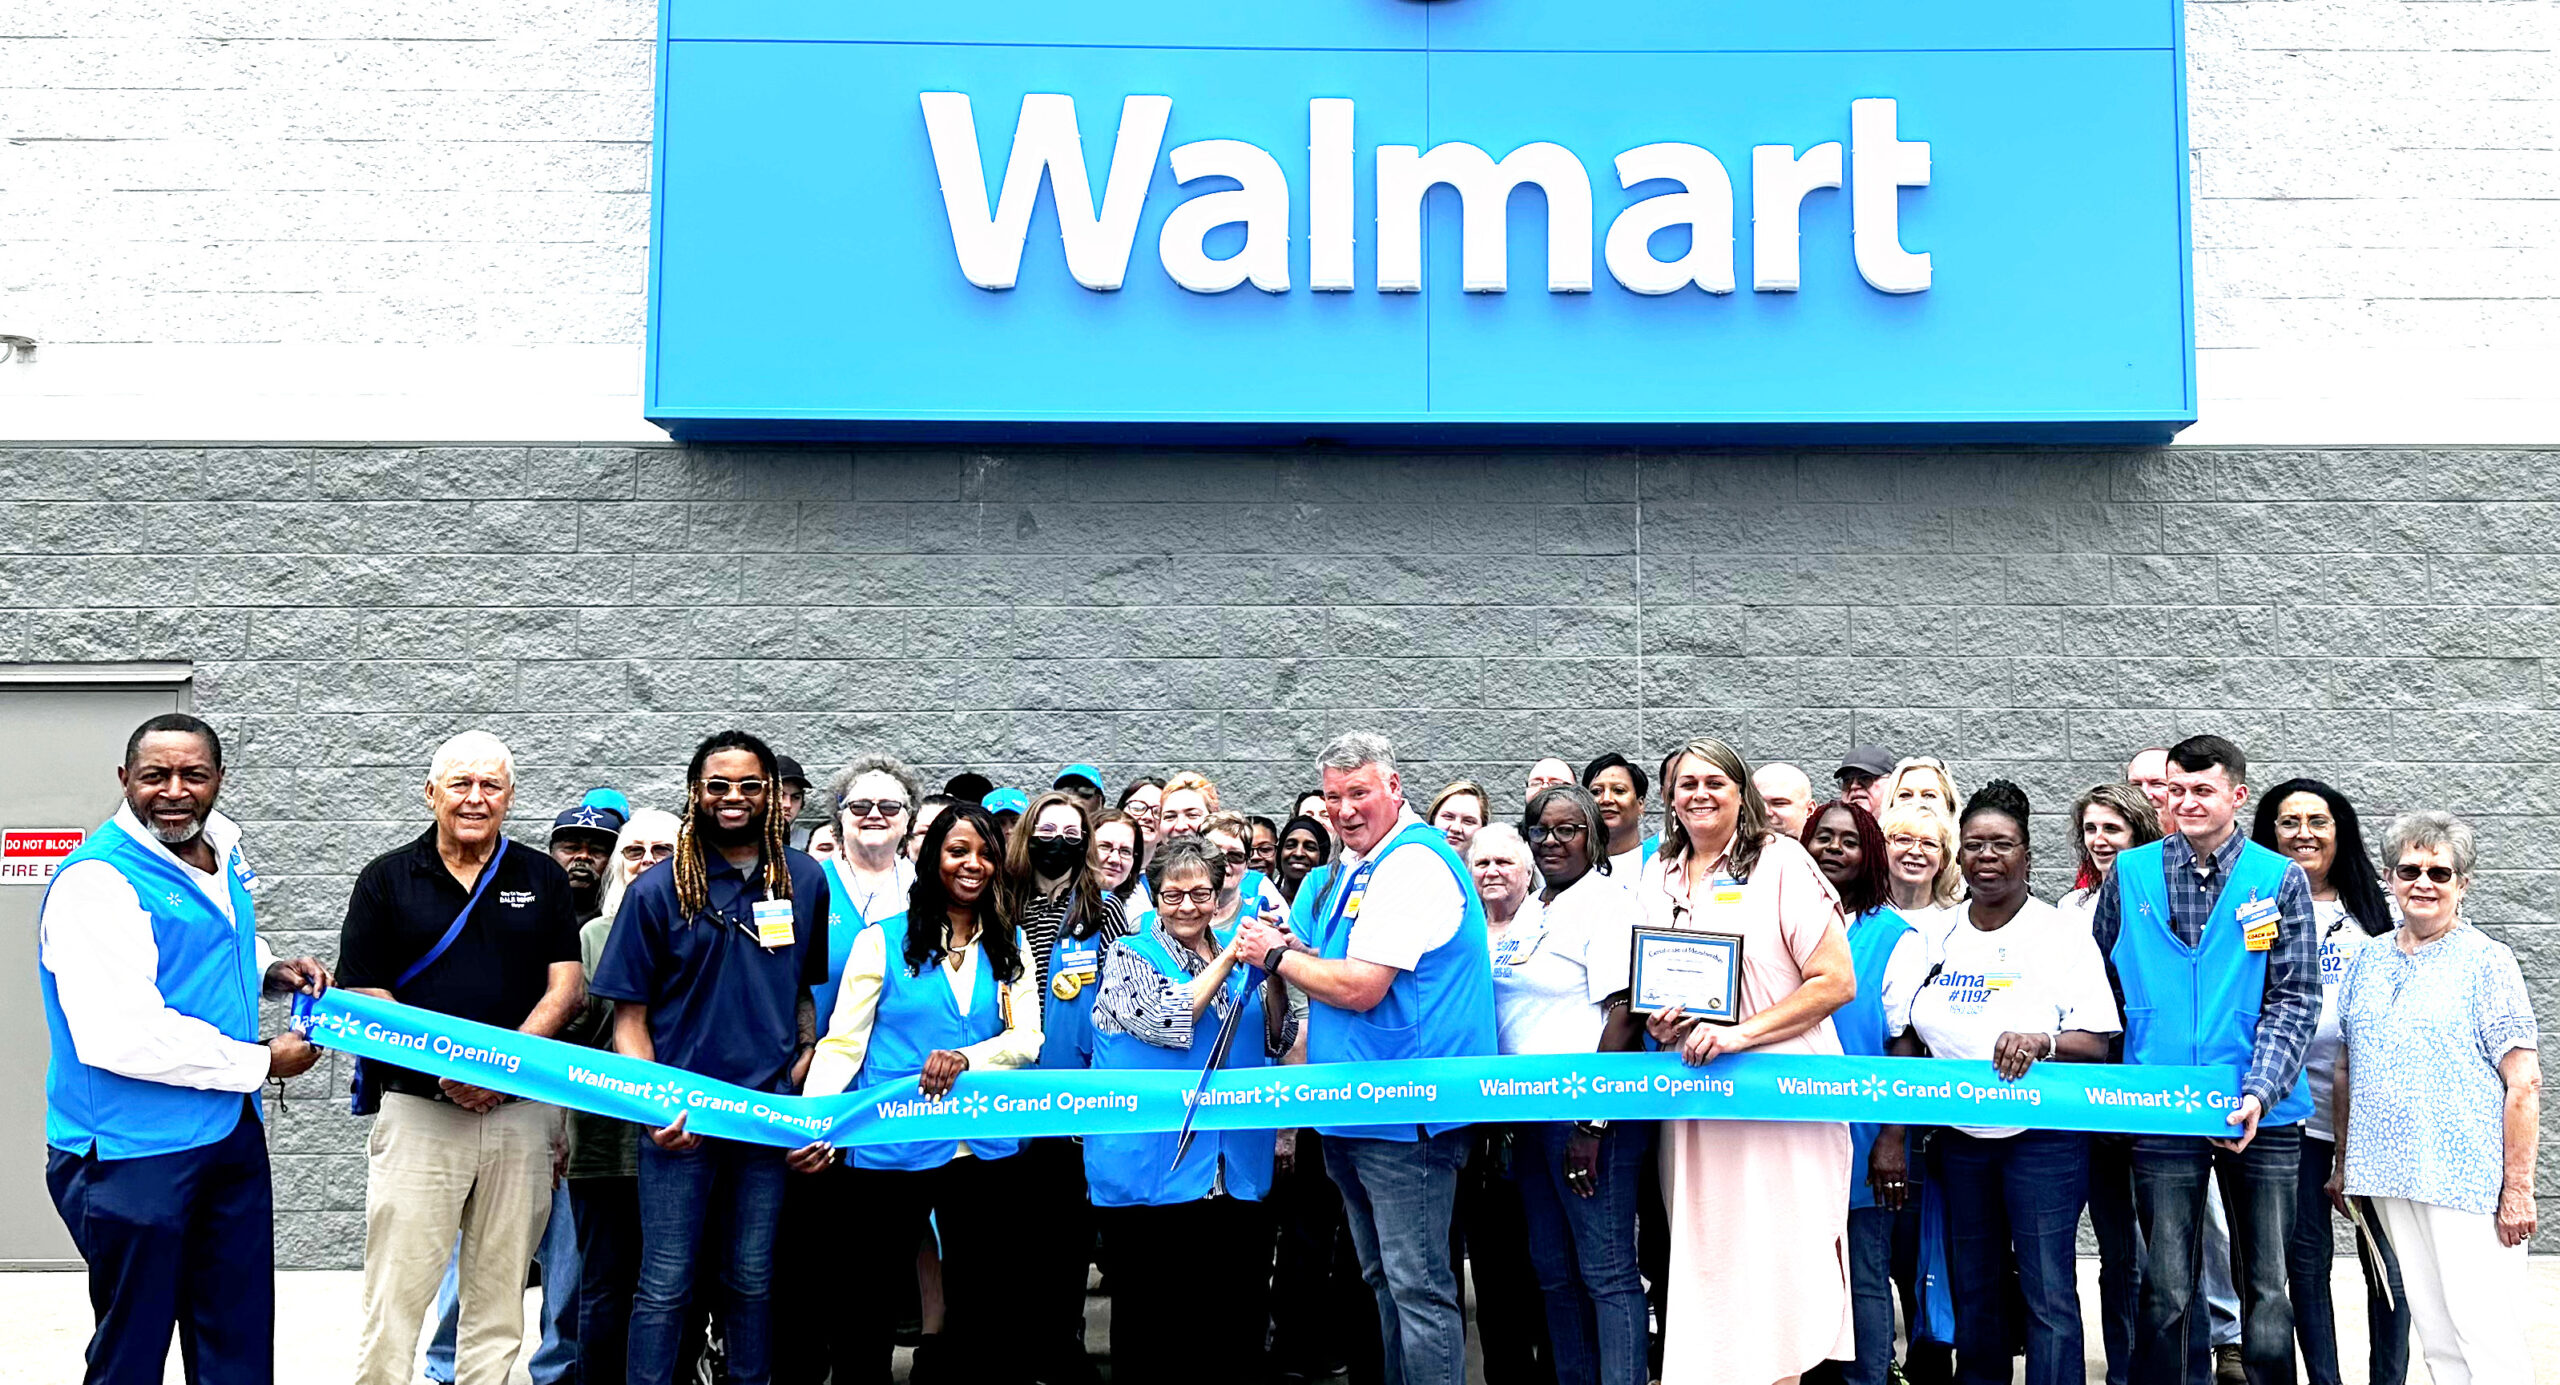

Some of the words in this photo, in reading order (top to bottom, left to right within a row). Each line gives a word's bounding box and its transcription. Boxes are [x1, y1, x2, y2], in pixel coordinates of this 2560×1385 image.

[919, 91, 1932, 295] Walmart
[6, 840, 20, 850] DO
[23, 840, 44, 850] NOT
[45, 840, 80, 850] BLOCK
[2, 864, 38, 877] FIRE
[1933, 970, 1985, 988] alma
[1948, 989, 1991, 1003] #1192
[364, 1022, 428, 1050] Grand
[433, 1036, 521, 1073] Opening
[1295, 1083, 1351, 1102] Grand
[1357, 1081, 1437, 1103] Opening
[1479, 1077, 1559, 1096] Walmart
[1592, 1075, 1648, 1093] Grand
[1654, 1075, 1734, 1097] Opening
[1777, 1077, 1858, 1096] Walmart
[1892, 1080, 1950, 1098] Grand
[1957, 1082, 2041, 1106] Opening
[567, 1065, 653, 1099] Walmart
[687, 1090, 747, 1114] Grand
[752, 1104, 834, 1131] Opening
[877, 1098, 959, 1119] Walmart
[993, 1093, 1050, 1113] Grand
[1057, 1091, 1138, 1114] Opening
[2085, 1087, 2171, 1107] Walmart
[2207, 1091, 2243, 1109] Gra
